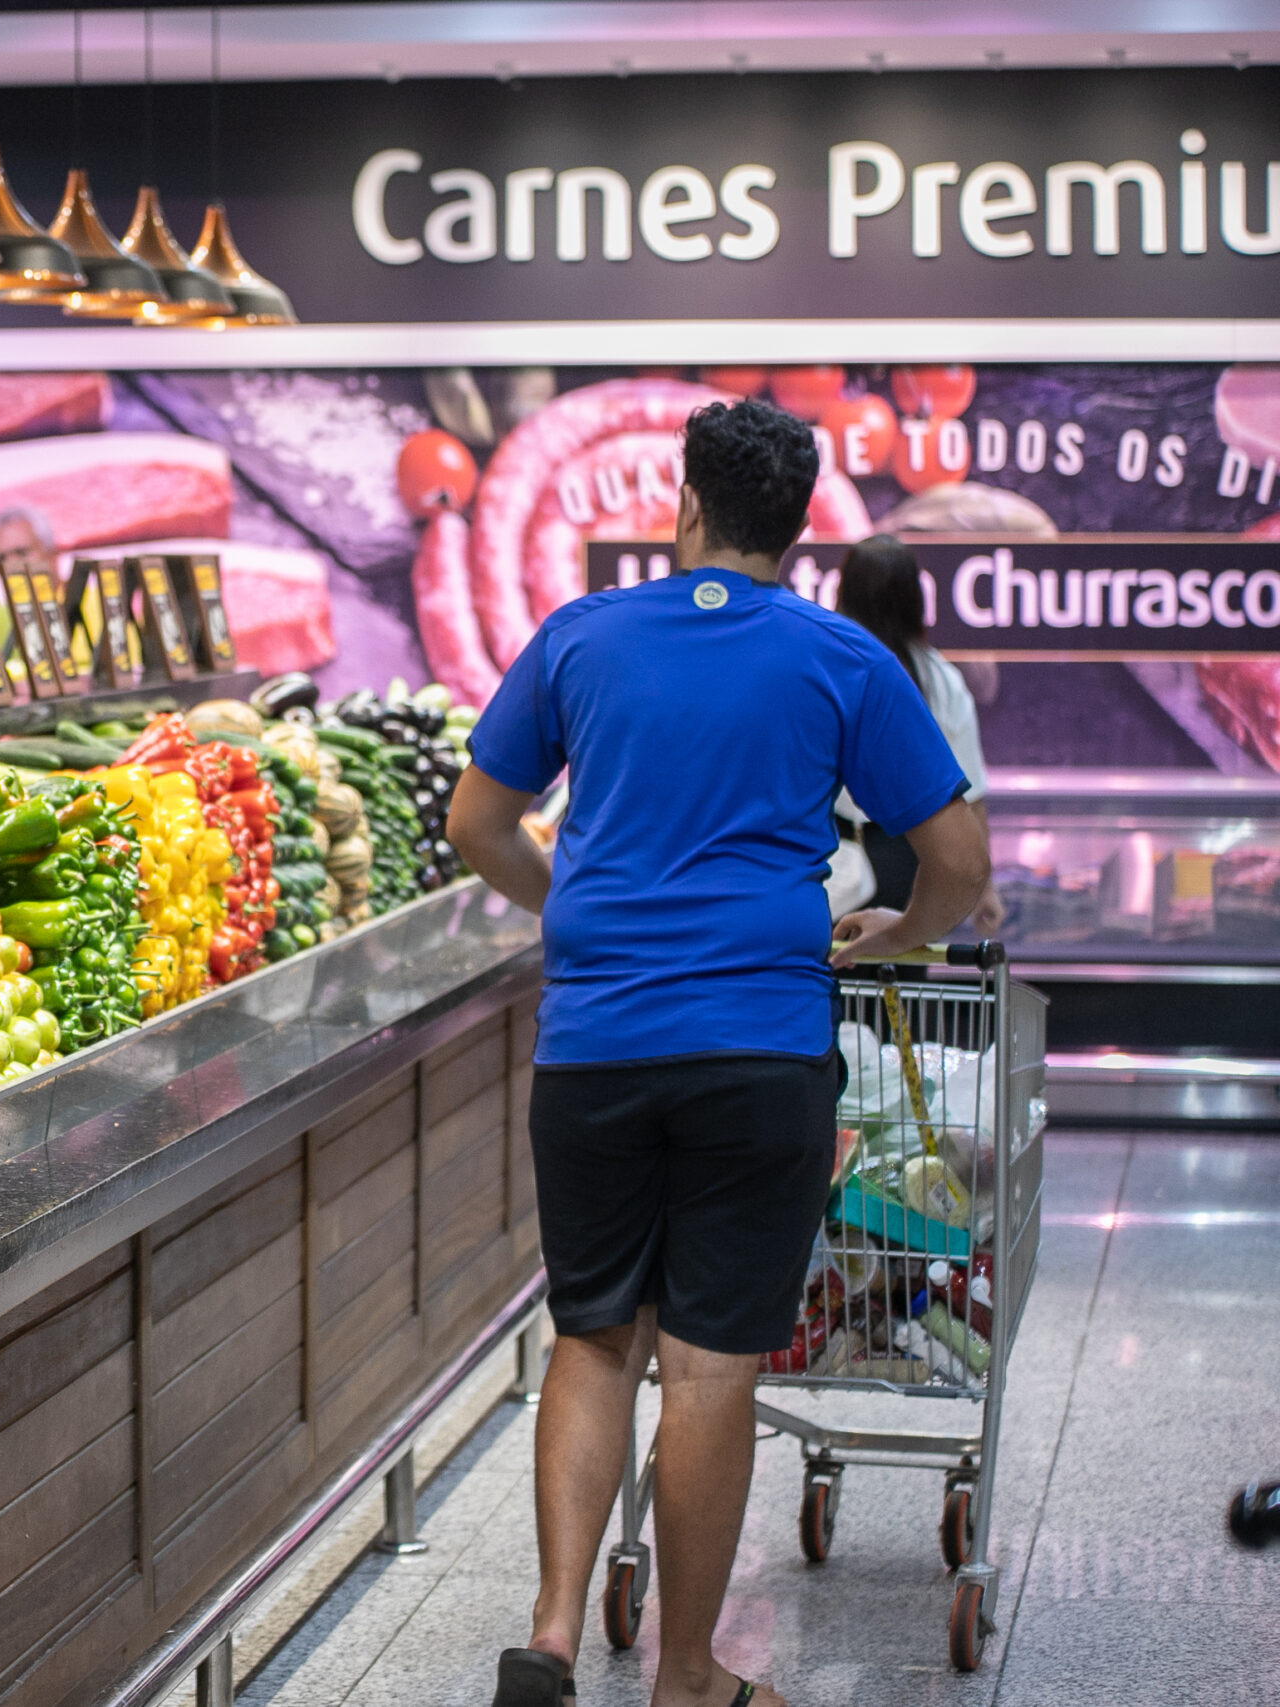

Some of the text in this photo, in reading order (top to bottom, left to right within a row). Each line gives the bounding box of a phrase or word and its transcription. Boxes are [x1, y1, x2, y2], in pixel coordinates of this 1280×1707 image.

[352, 148, 780, 265] Carnes
[902, 417, 1086, 477] TODOS
[1116, 428, 1188, 488] OS
[952, 547, 1280, 628] Churrasco
